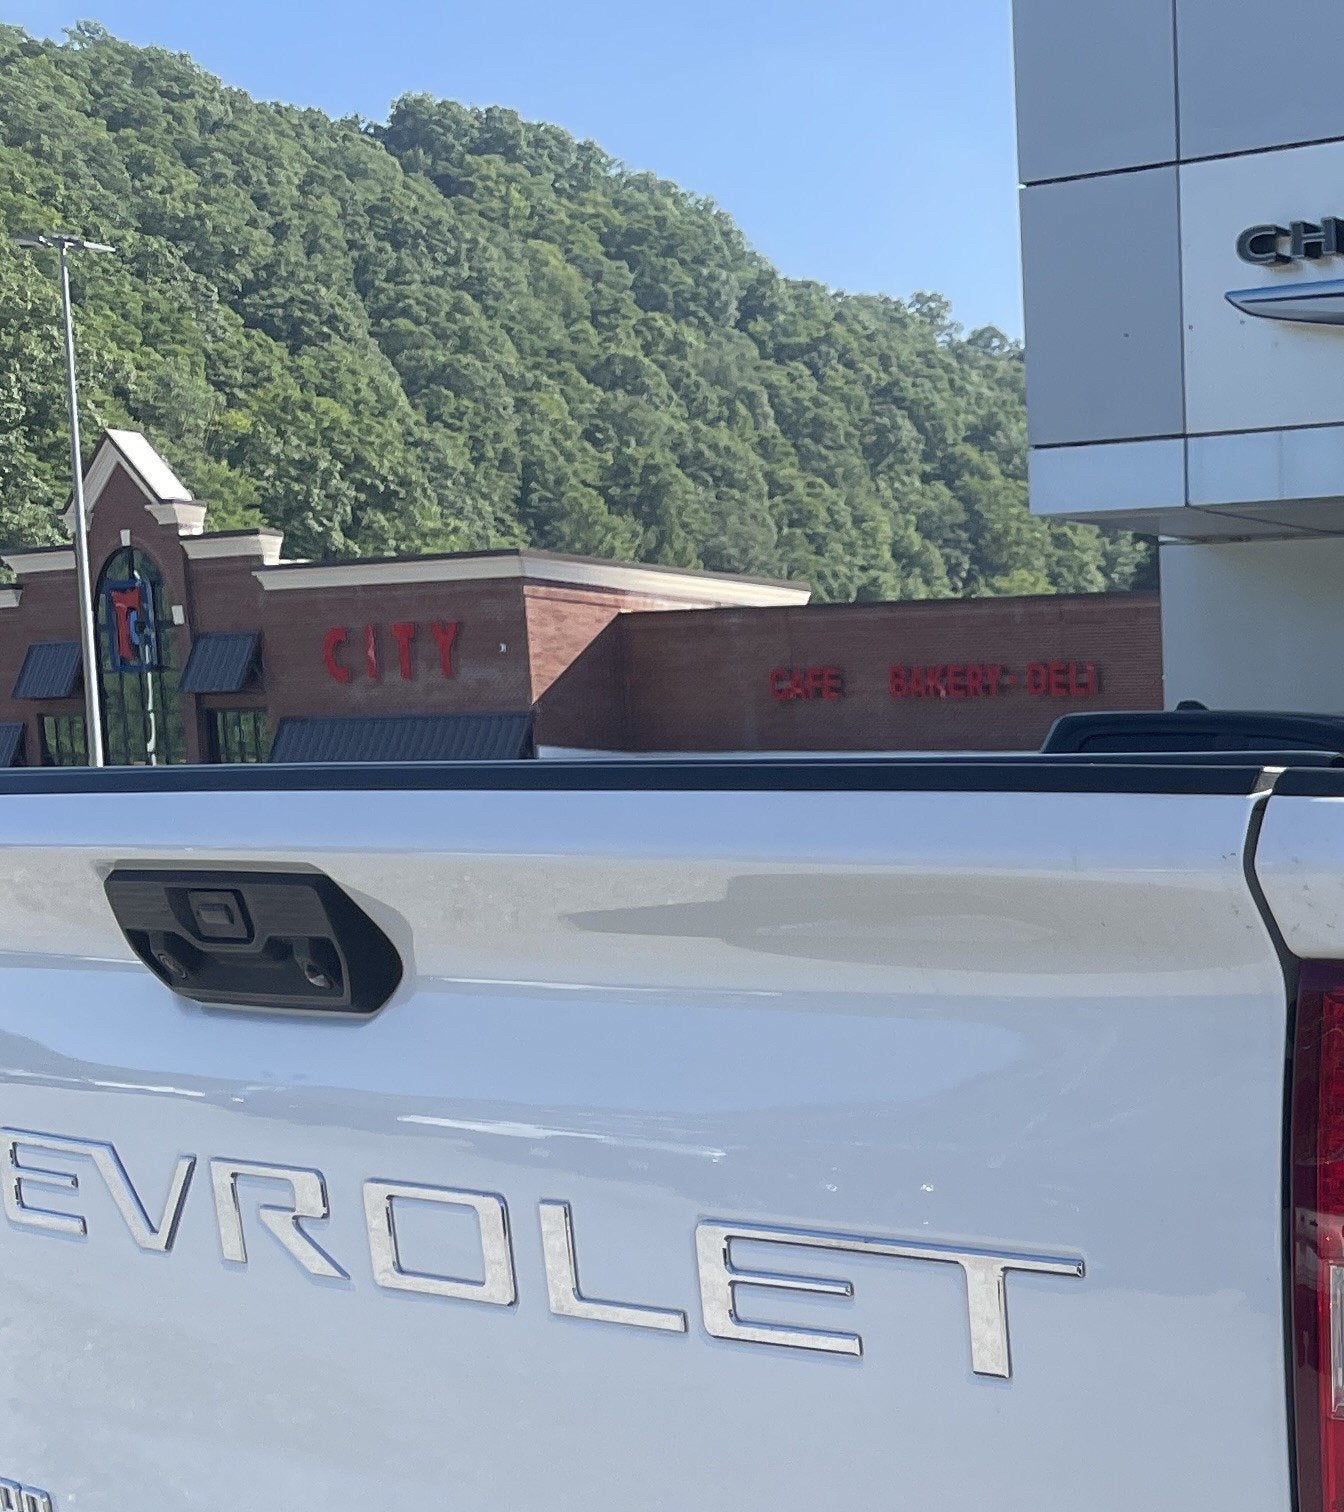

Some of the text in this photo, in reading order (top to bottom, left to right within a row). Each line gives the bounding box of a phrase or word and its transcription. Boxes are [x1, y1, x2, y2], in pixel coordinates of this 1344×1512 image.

[322, 621, 460, 684] CITY
[767, 666, 842, 700] CAFE
[0, 1126, 1087, 1380] EVROLET
